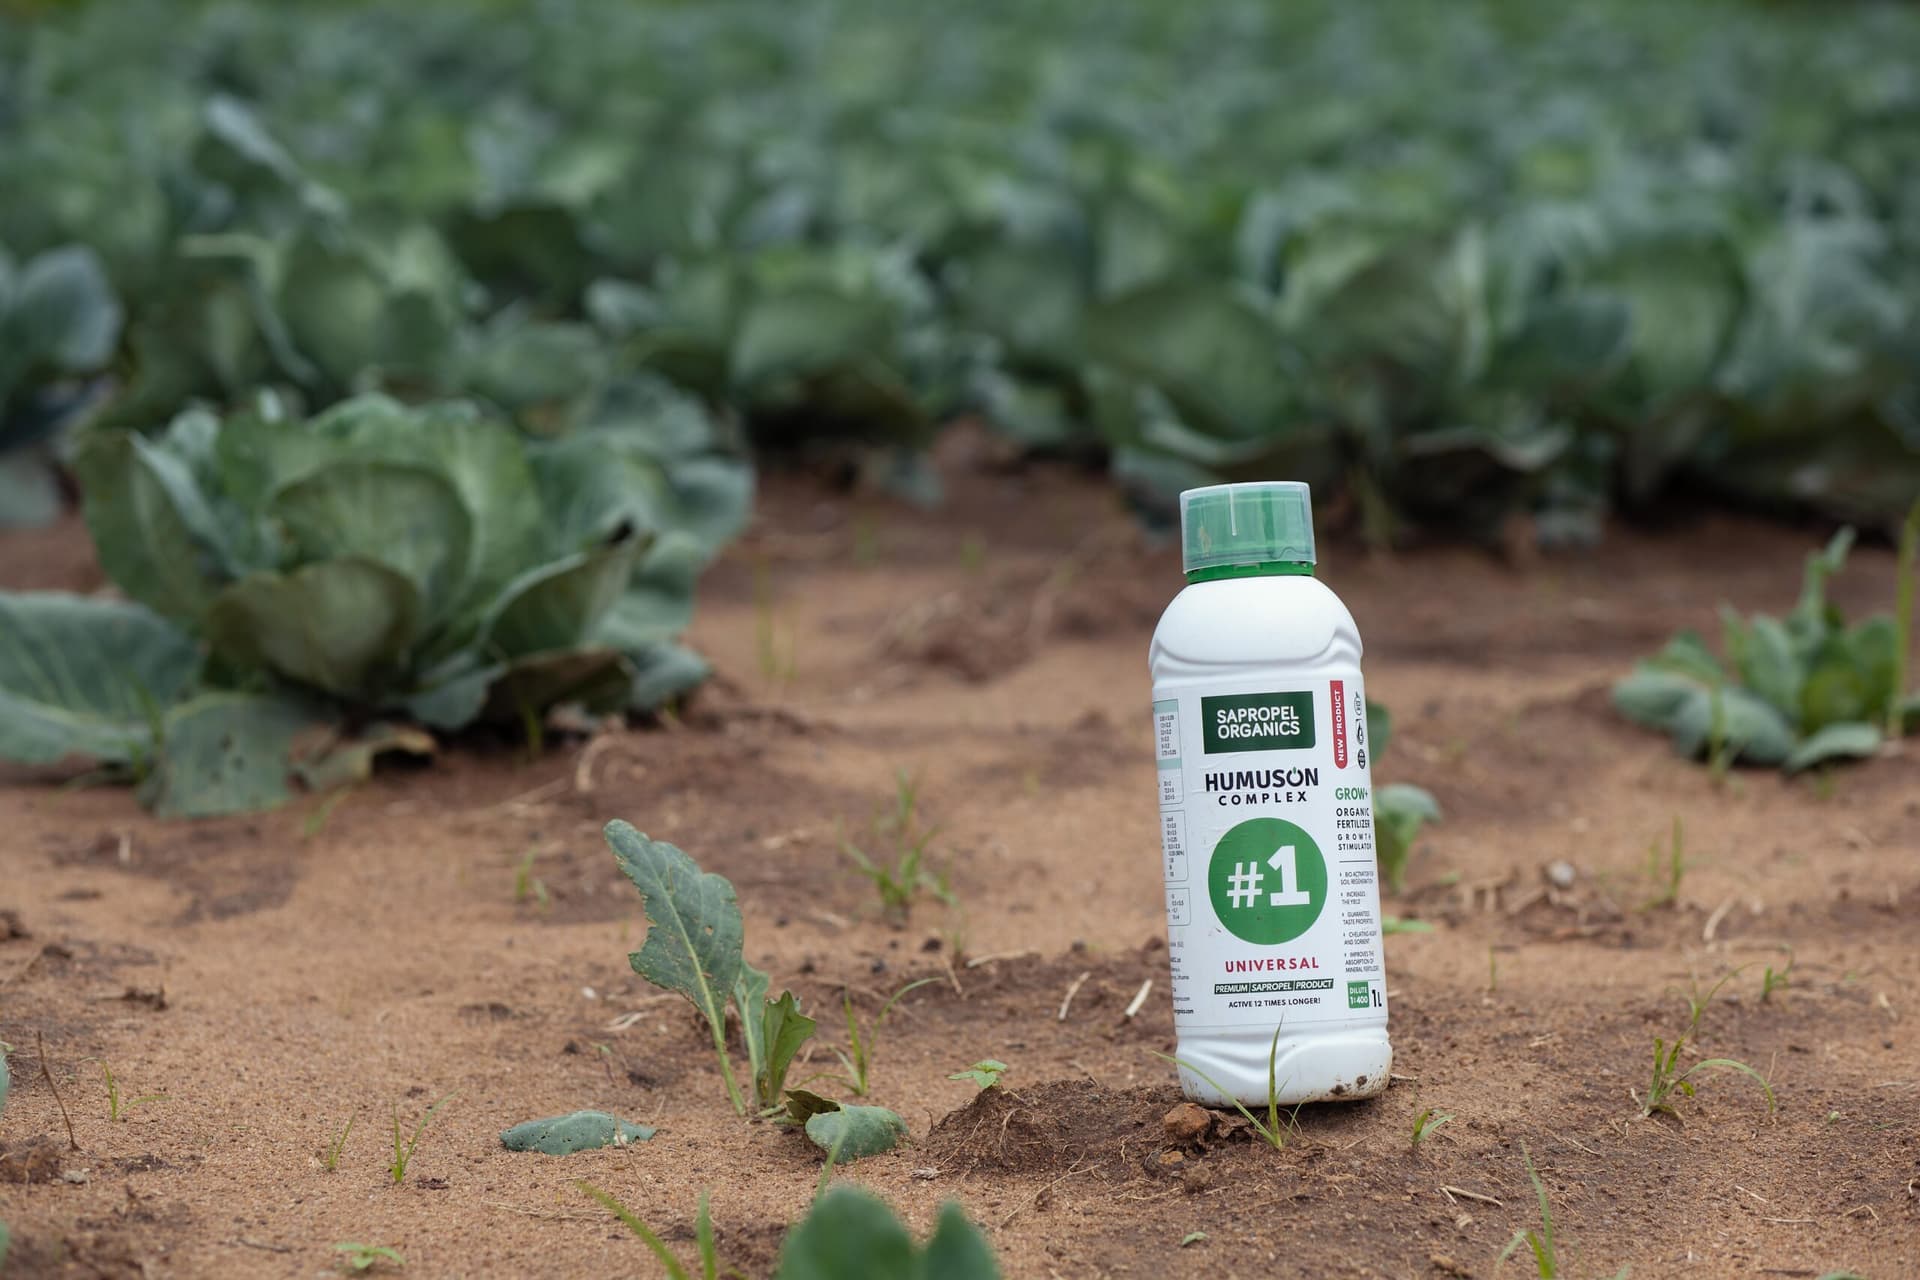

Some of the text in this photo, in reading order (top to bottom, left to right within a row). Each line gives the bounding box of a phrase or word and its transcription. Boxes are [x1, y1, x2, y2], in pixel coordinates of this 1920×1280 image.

[1217, 706, 1299, 724] SAPROPEL
[1335, 690, 1344, 734] PRODUCT
[1218, 721, 1300, 739] ORGANICS
[1205, 767, 1319, 792] HUMUSON
[1219, 791, 1307, 806] COMPLEX
[1335, 787, 1368, 800] GROW+
[1336, 808, 1370, 817] ORGANIC
[1337, 819, 1370, 829] FERTILIZER
[1226, 845, 1311, 909] #1
[1225, 957, 1319, 973] UNIVERSAL
[1215, 979, 1333, 994] PREMIUM SAPROPEL PRODUCT
[1228, 1000, 1252, 1008] ACTIVE
[1288, 998, 1321, 1006] LONGER!
[1372, 989, 1382, 1008] 1L
